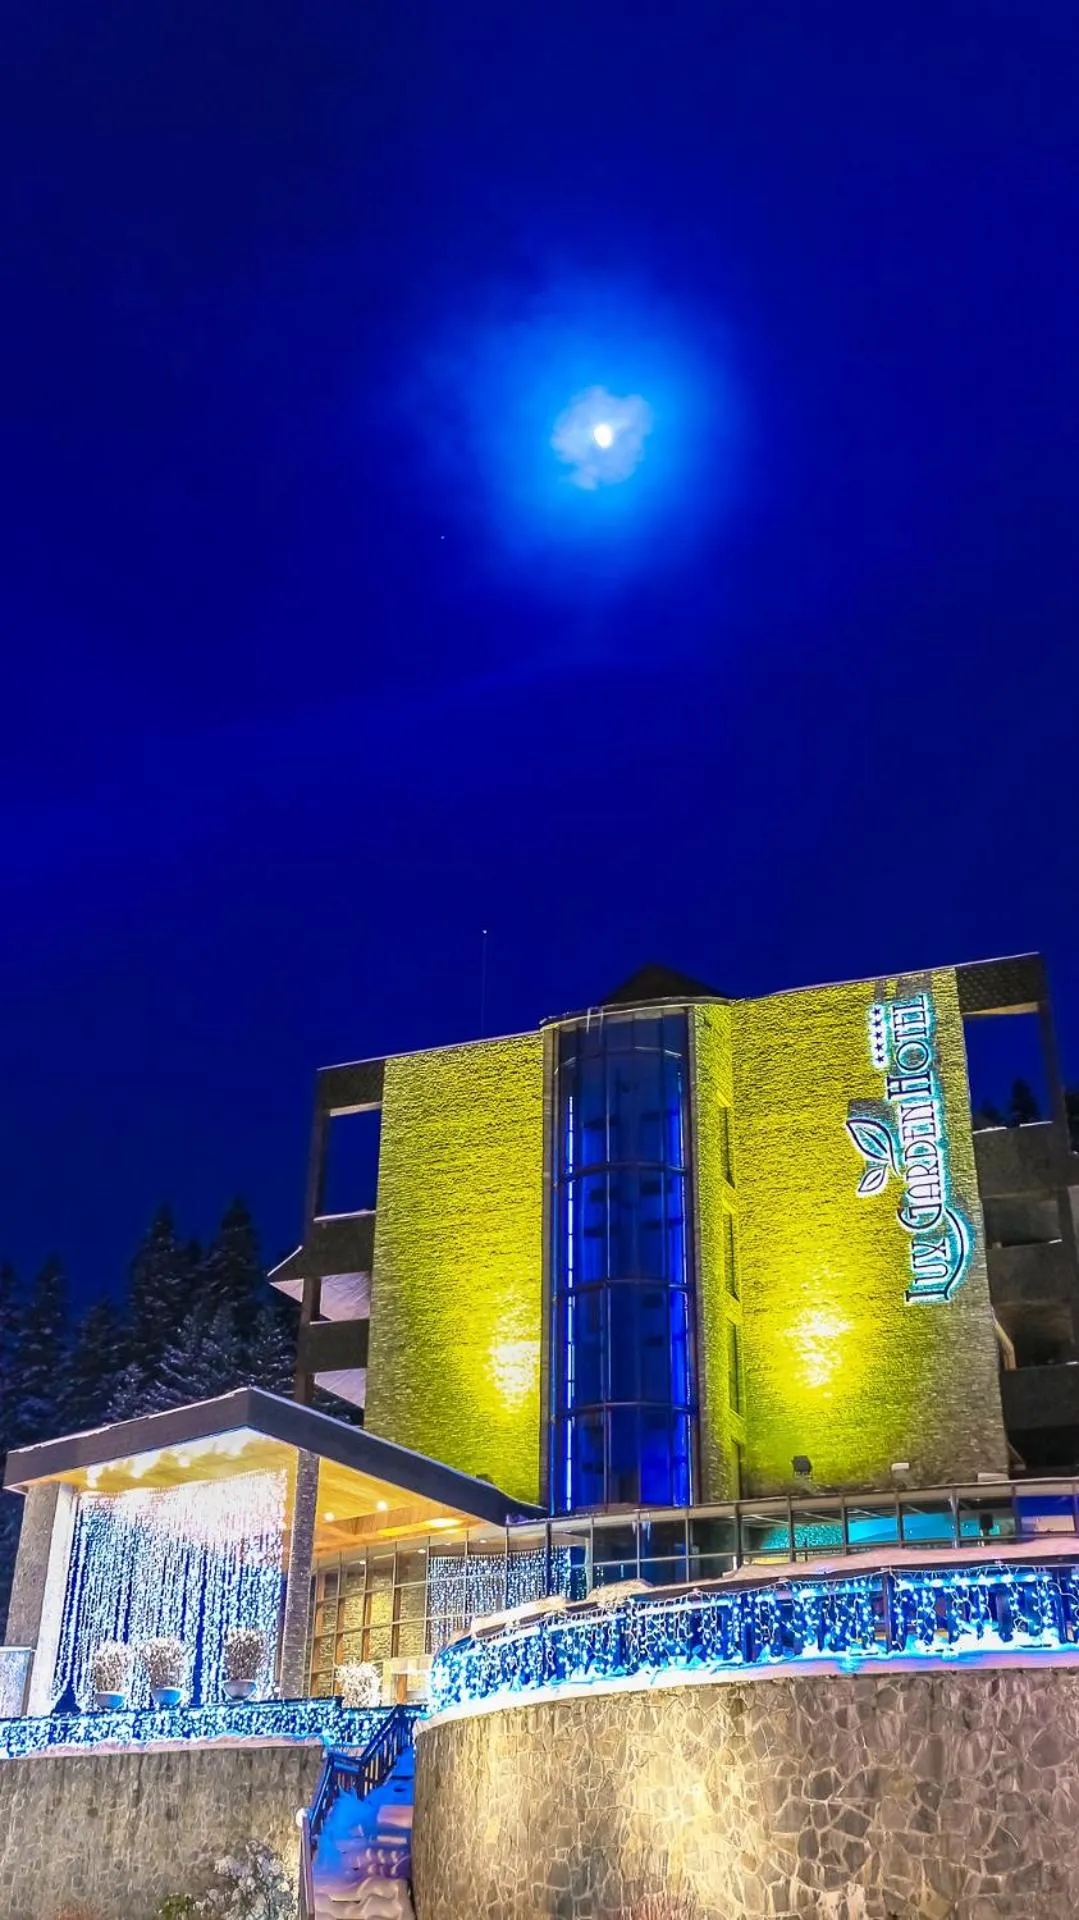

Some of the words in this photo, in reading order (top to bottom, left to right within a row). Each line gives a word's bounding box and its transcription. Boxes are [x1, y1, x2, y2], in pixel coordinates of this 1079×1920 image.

[886, 994, 931, 1099] HOTEL
[897, 1101, 944, 1230] GARDEN
[905, 1237, 950, 1302] LUX
